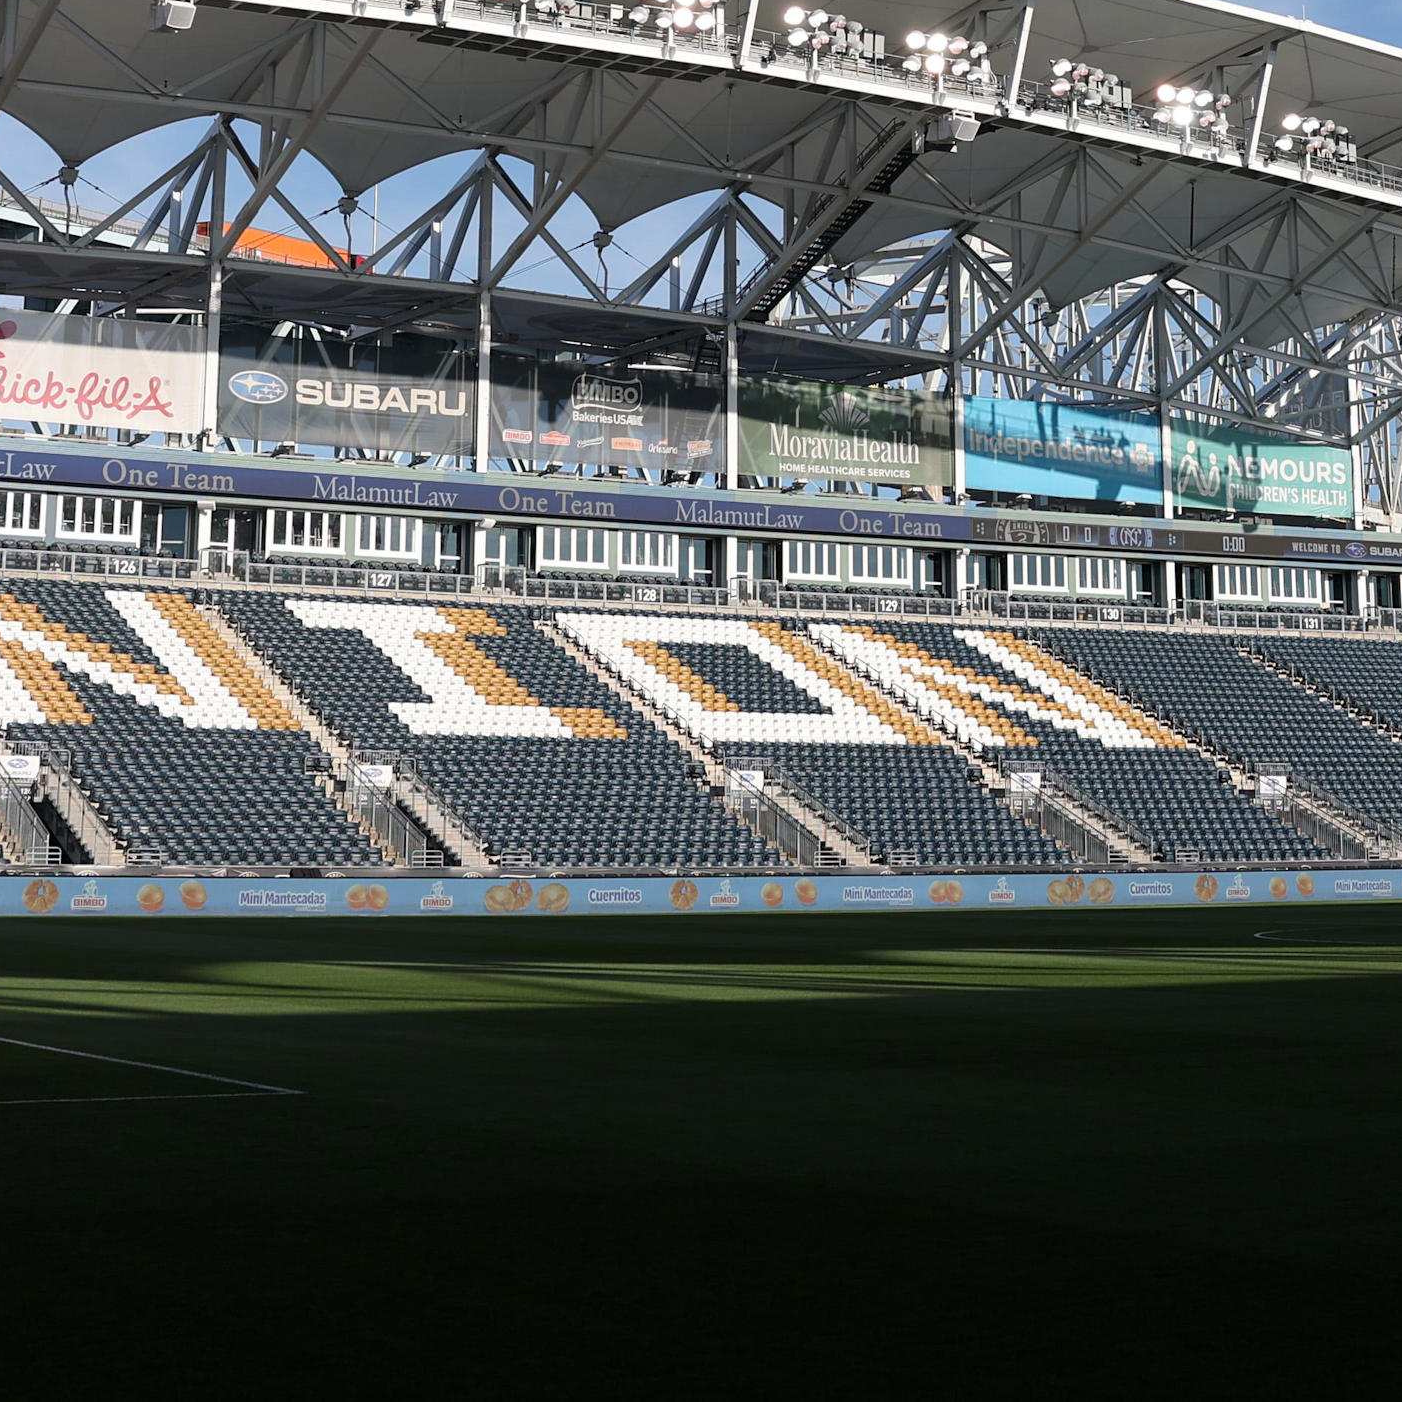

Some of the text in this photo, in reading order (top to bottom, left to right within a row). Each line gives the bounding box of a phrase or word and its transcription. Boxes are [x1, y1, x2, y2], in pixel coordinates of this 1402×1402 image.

[295, 379, 466, 416] SUBARU
[576, 380, 639, 404] BIMBO
[572, 411, 613, 424] Bakeries
[769, 422, 920, 465] MoraviaHealth
[969, 428, 1126, 467] Independence
[102, 459, 235, 492] One Team
[779, 462, 910, 479] HOME HEALTHCARE SERVICES
[1227, 455, 1346, 486] NEMOURS
[312, 475, 458, 509] MalamutLaw
[1229, 482, 1347, 507] CHILDREN'S HEALTH
[498, 487, 616, 517] One Team
[675, 500, 803, 530] MalamutLaw
[839, 510, 943, 538] One Team
[1062, 525, 1071, 542] 0
[1084, 527, 1092, 543] 0
[1222, 536, 1245, 553] 0:00
[1292, 541, 1341, 554] WELCOME TO
[113, 559, 136, 575] 126
[370, 573, 392, 588] 127
[636, 588, 656, 602] 128
[880, 599, 898, 613] 129
[1102, 608, 1120, 622] 130
[1303, 617, 1319, 631] 131
[1130, 882, 1171, 895] Cuernitos
[1352, 879, 1391, 891] Mantecadas
[240, 891, 325, 905] Mini Mantecadas
[589, 887, 641, 903] Cuernitos
[844, 888, 912, 901] Mini Mantecadas
[73, 899, 105, 907] BIMBO
